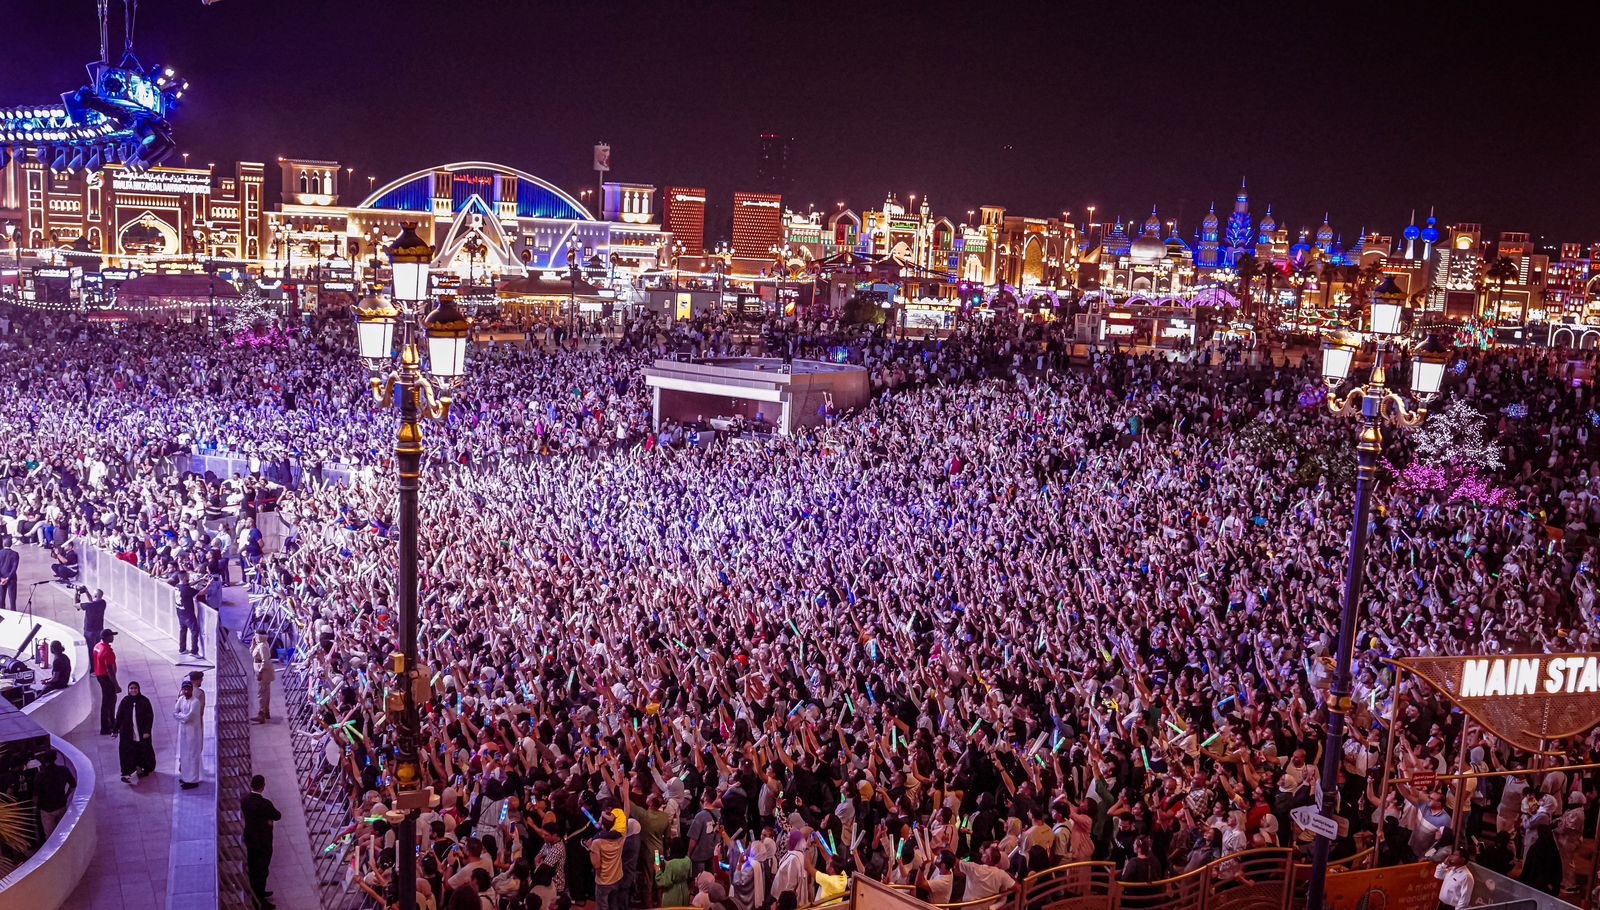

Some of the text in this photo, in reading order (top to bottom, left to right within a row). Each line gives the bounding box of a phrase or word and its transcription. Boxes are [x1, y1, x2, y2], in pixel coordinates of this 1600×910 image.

[790, 235, 819, 244] PAKISTAN
[1460, 656, 1600, 697] MAIN STA
